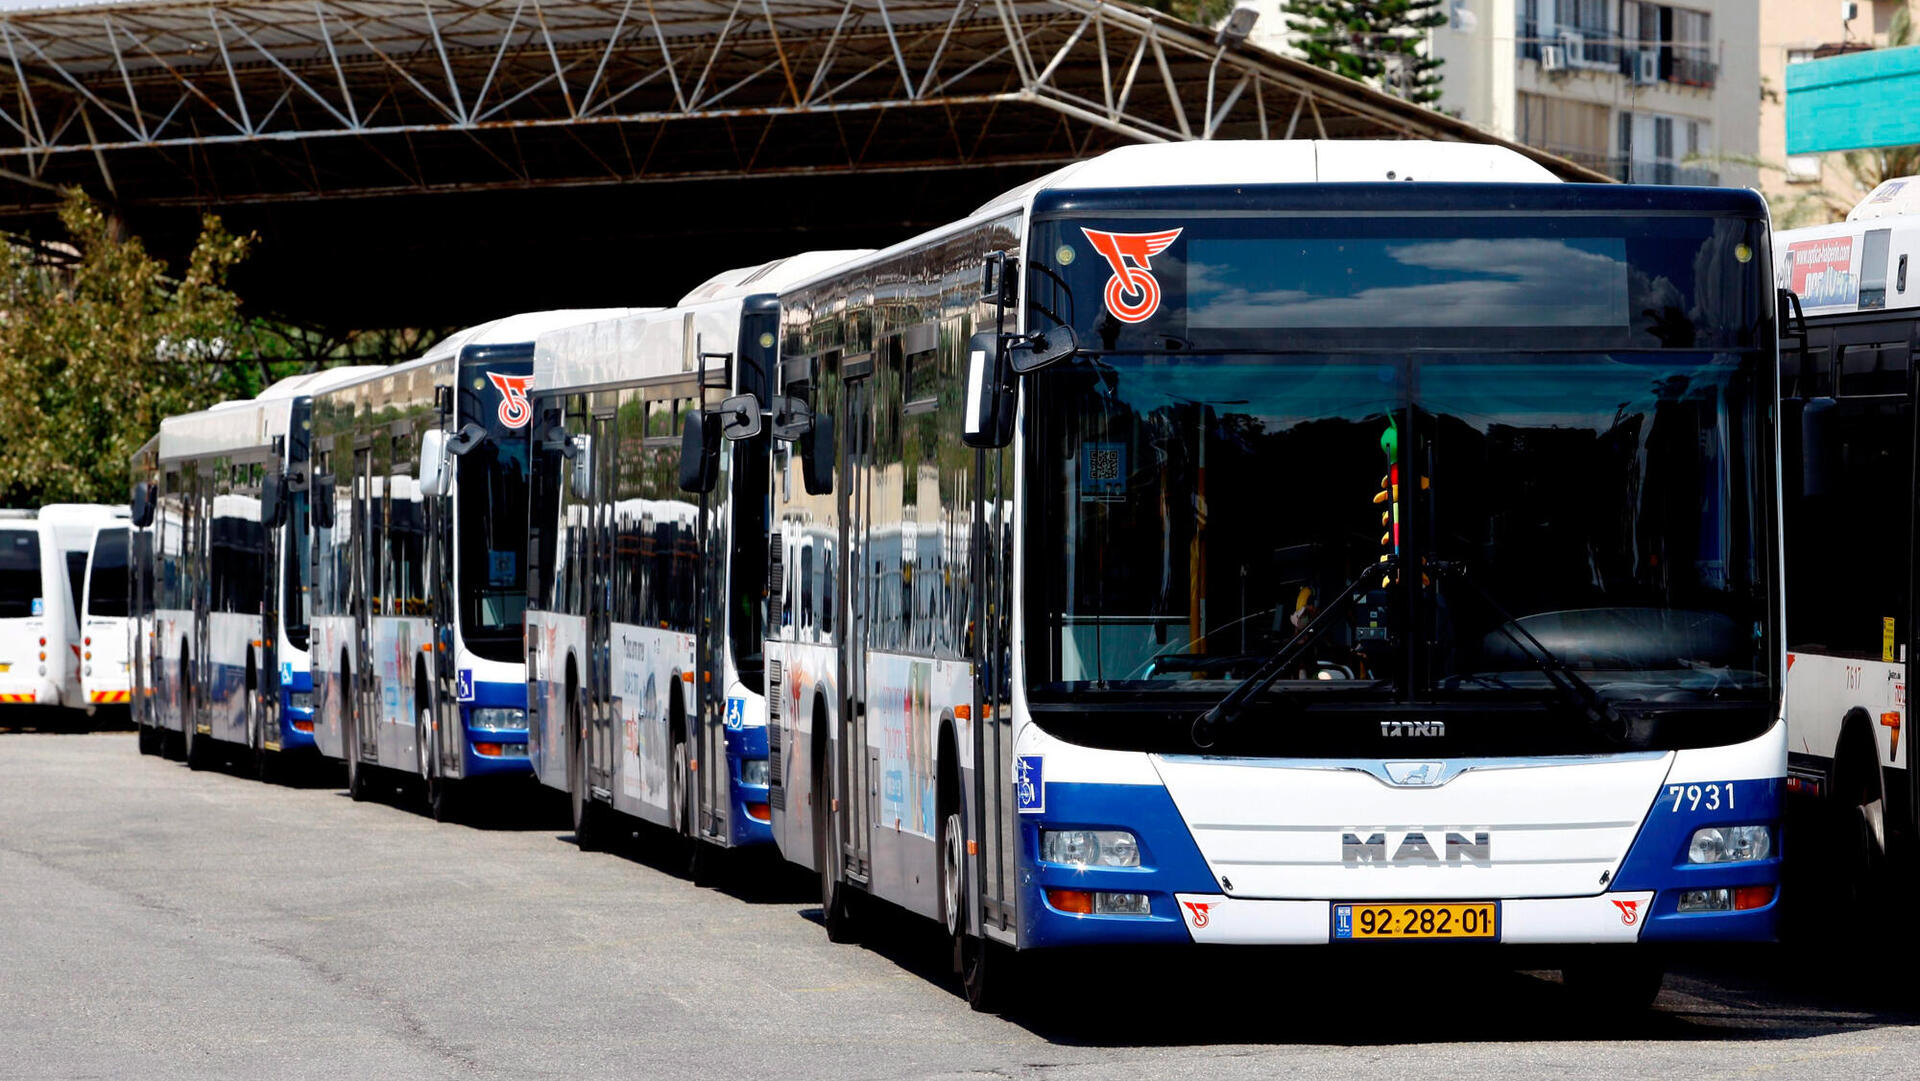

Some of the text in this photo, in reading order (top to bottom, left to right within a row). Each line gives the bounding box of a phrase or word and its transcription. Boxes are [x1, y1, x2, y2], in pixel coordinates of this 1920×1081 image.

[1845, 664, 1862, 690] 7617
[1380, 720, 1446, 737] הארגז
[1669, 782, 1734, 813] 7931
[1342, 832, 1491, 862] MAN
[1339, 915, 1350, 929] IL
